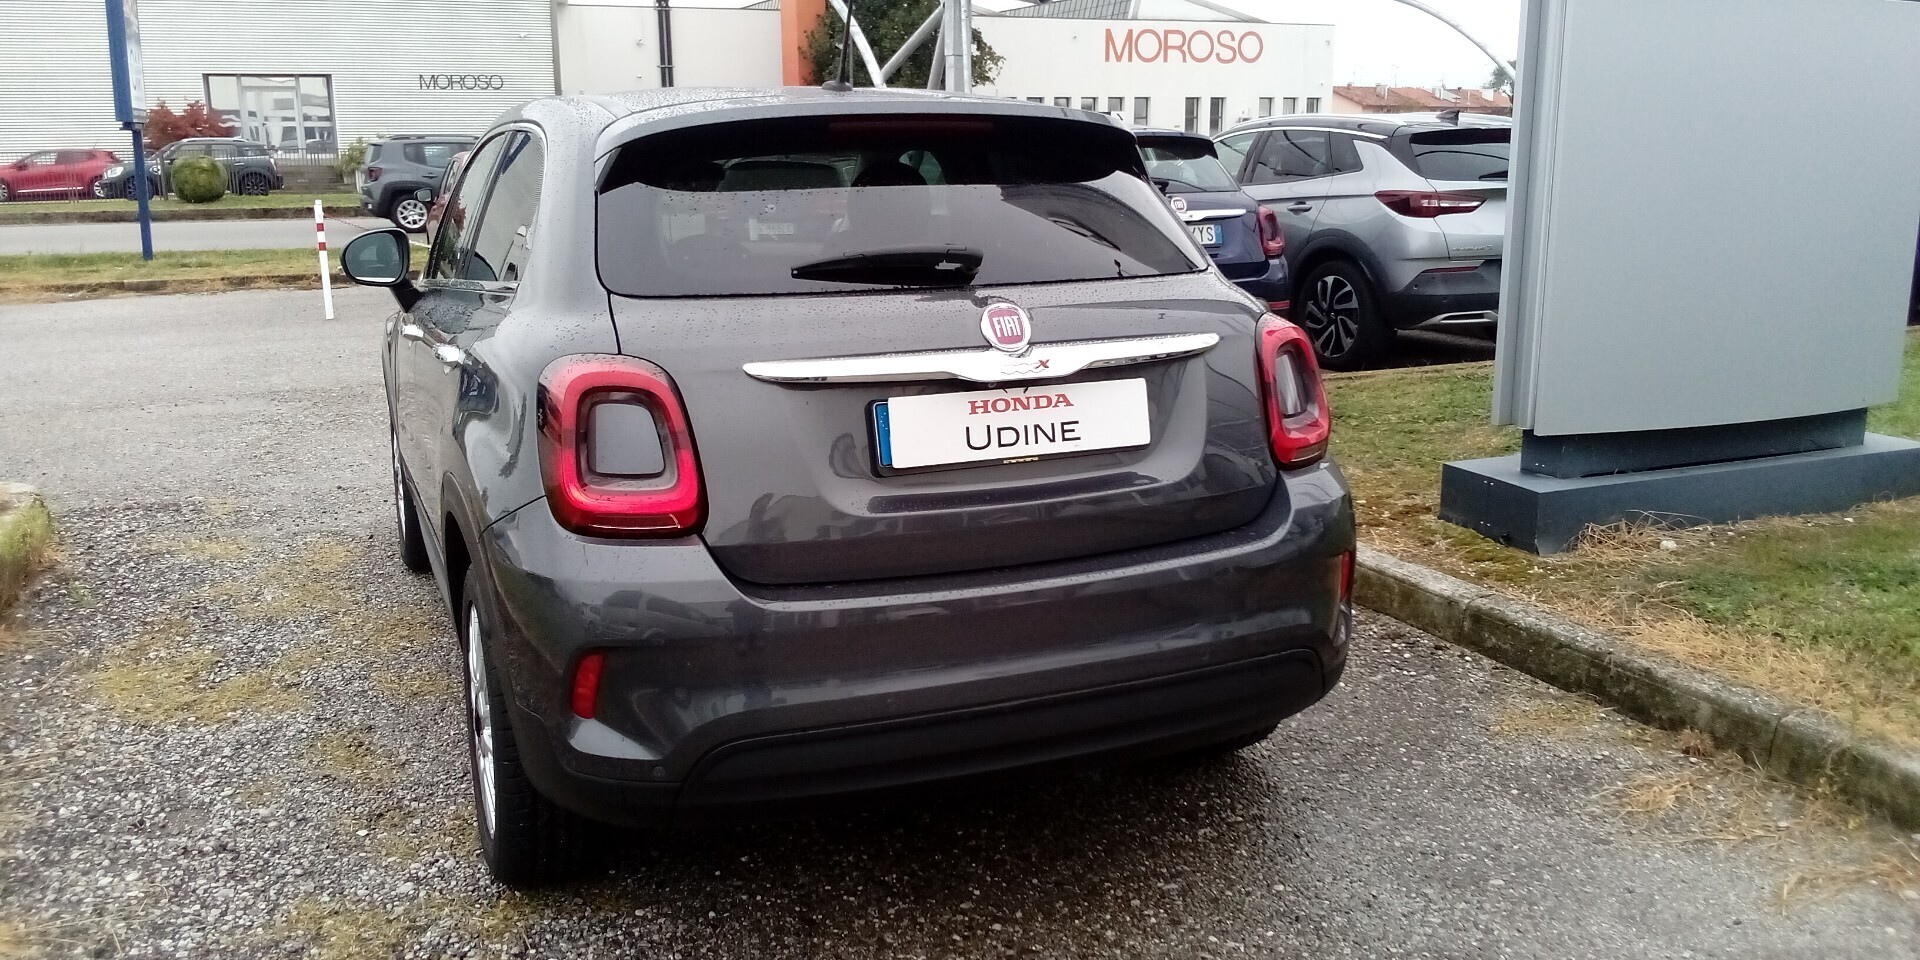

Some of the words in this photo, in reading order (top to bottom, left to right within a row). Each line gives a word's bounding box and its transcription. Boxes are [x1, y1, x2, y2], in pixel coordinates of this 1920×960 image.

[1104, 28, 1264, 64] MOROSO
[419, 74, 504, 90] MOROSO
[992, 315, 1022, 338] FIAT
[968, 393, 1074, 415] HONDA
[965, 420, 1081, 450] UDINE
